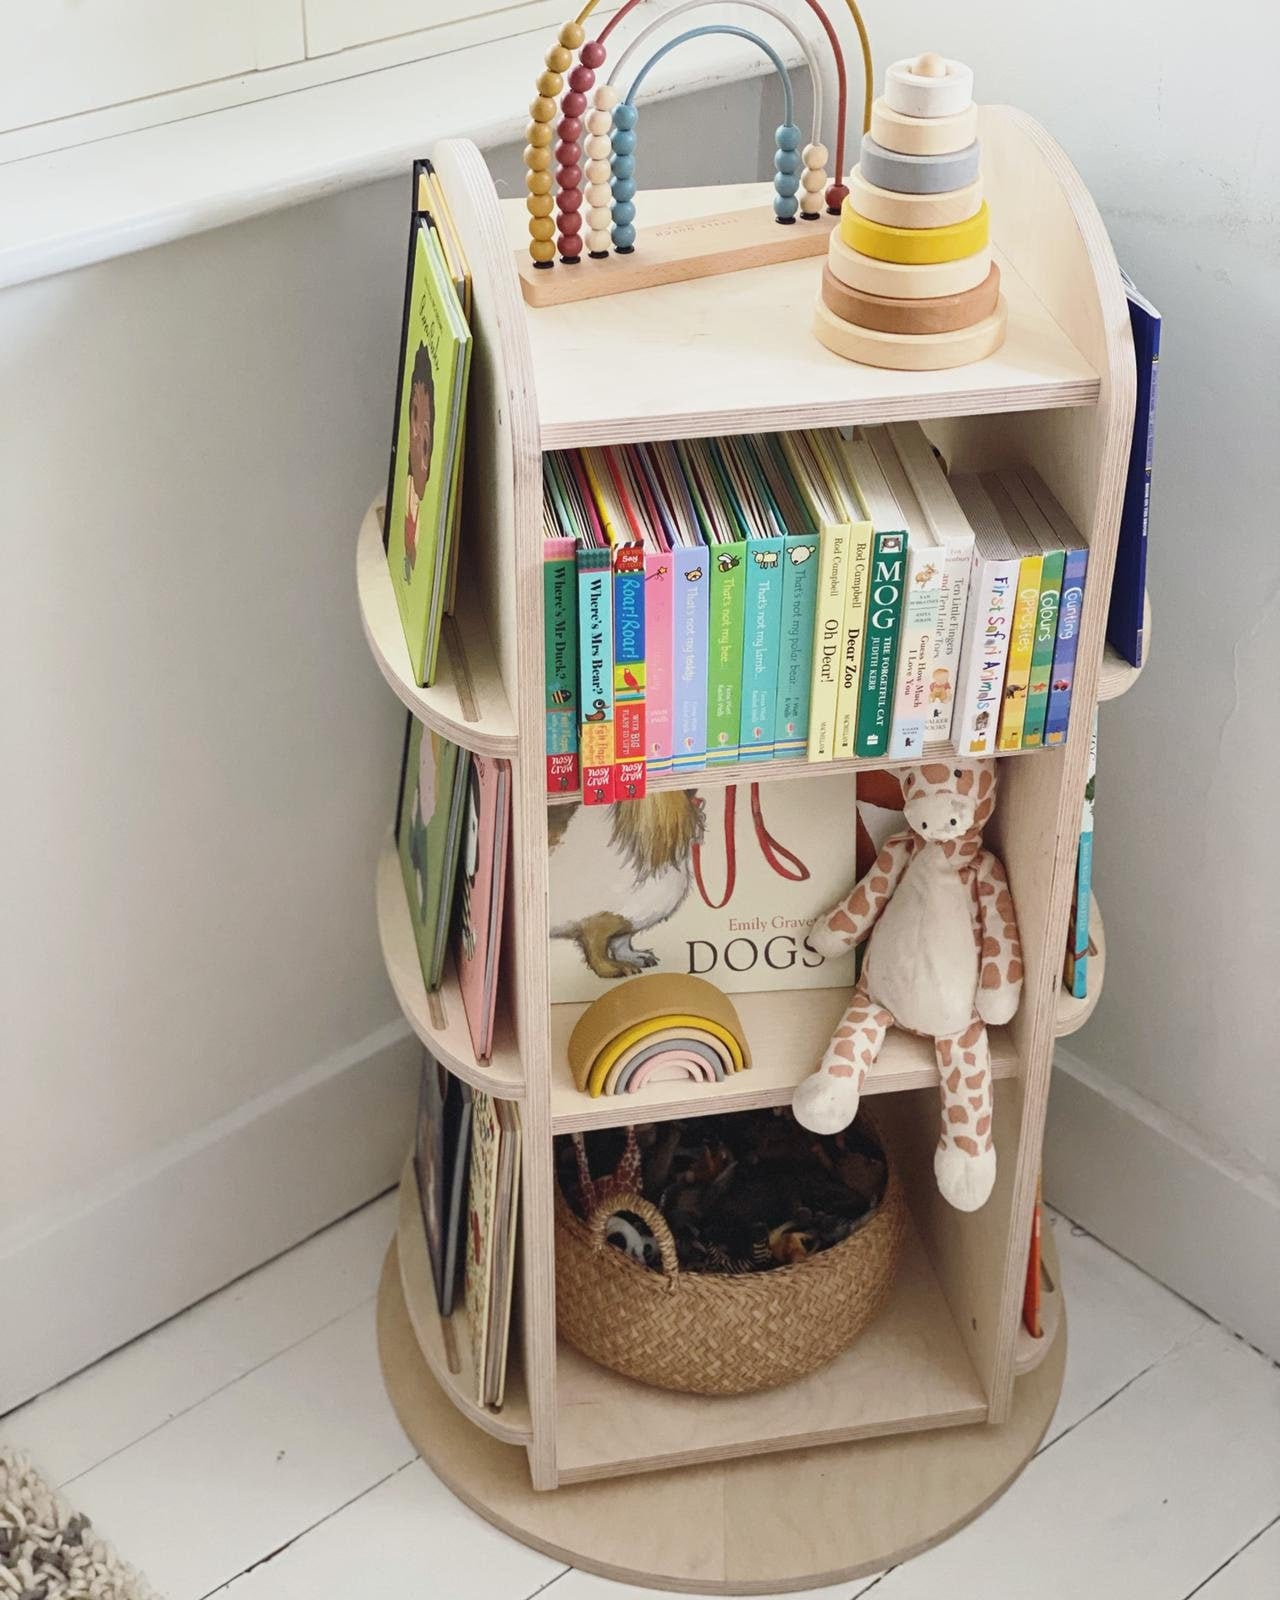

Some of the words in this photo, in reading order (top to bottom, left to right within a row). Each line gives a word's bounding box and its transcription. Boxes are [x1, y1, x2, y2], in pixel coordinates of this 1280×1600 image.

[833, 538, 843, 554] Rod
[856, 543, 867, 561] Rod
[794, 568, 807, 598] That's
[830, 556, 842, 597] Campbell
[851, 564, 865, 608] Campbell
[941, 574, 950, 592] and
[953, 578, 964, 596] Ten
[554, 566, 566, 618] Where's
[622, 578, 641, 618] Roar!
[722, 576, 735, 607] That's
[758, 580, 770, 610] That's
[872, 560, 902, 629] MOG
[938, 593, 949, 611] Ten
[988, 576, 1009, 612] First
[590, 578, 602, 630] Where's
[792, 600, 802, 618] not
[950, 597, 962, 622] Little
[1060, 586, 1082, 640] Counting
[686, 618, 696, 634] not
[722, 609, 731, 626] not
[756, 612, 766, 630] not
[1038, 590, 1060, 642] Colours
[555, 620, 566, 639] Mr
[621, 619, 641, 658] Roar!
[718, 629, 729, 644] my
[752, 632, 764, 647] my
[788, 620, 800, 636] my
[824, 619, 839, 640] Oh
[945, 622, 958, 656] Fingers
[984, 616, 1006, 655] Safari
[591, 632, 603, 657] Mrs
[682, 637, 694, 654] my
[788, 638, 802, 662] polar
[846, 629, 860, 662] Dear
[870, 636, 881, 668] JUDITH
[882, 636, 892, 654] THE
[919, 634, 930, 660] Guess
[555, 642, 568, 680] Duck?
[820, 645, 837, 682] Dear!
[906, 656, 916, 676] Love
[916, 662, 926, 682] How
[592, 660, 604, 695] Bear?
[844, 665, 857, 688] Zoo
[868, 669, 878, 691] KERR
[878, 656, 890, 708] FORGETFUL
[904, 678, 914, 696] You
[976, 662, 1000, 710] Animals
[914, 684, 924, 708] Much
[622, 709, 630, 729] FLAPS
[632, 714, 640, 732] WITH
[876, 709, 885, 726] CAT
[630, 732, 640, 748] BIG
[552, 755, 574, 765] nosy
[622, 763, 643, 773] nosy
[588, 768, 610, 778] nosy
[728, 916, 768, 932] Emily
[686, 935, 826, 974] DOGS
